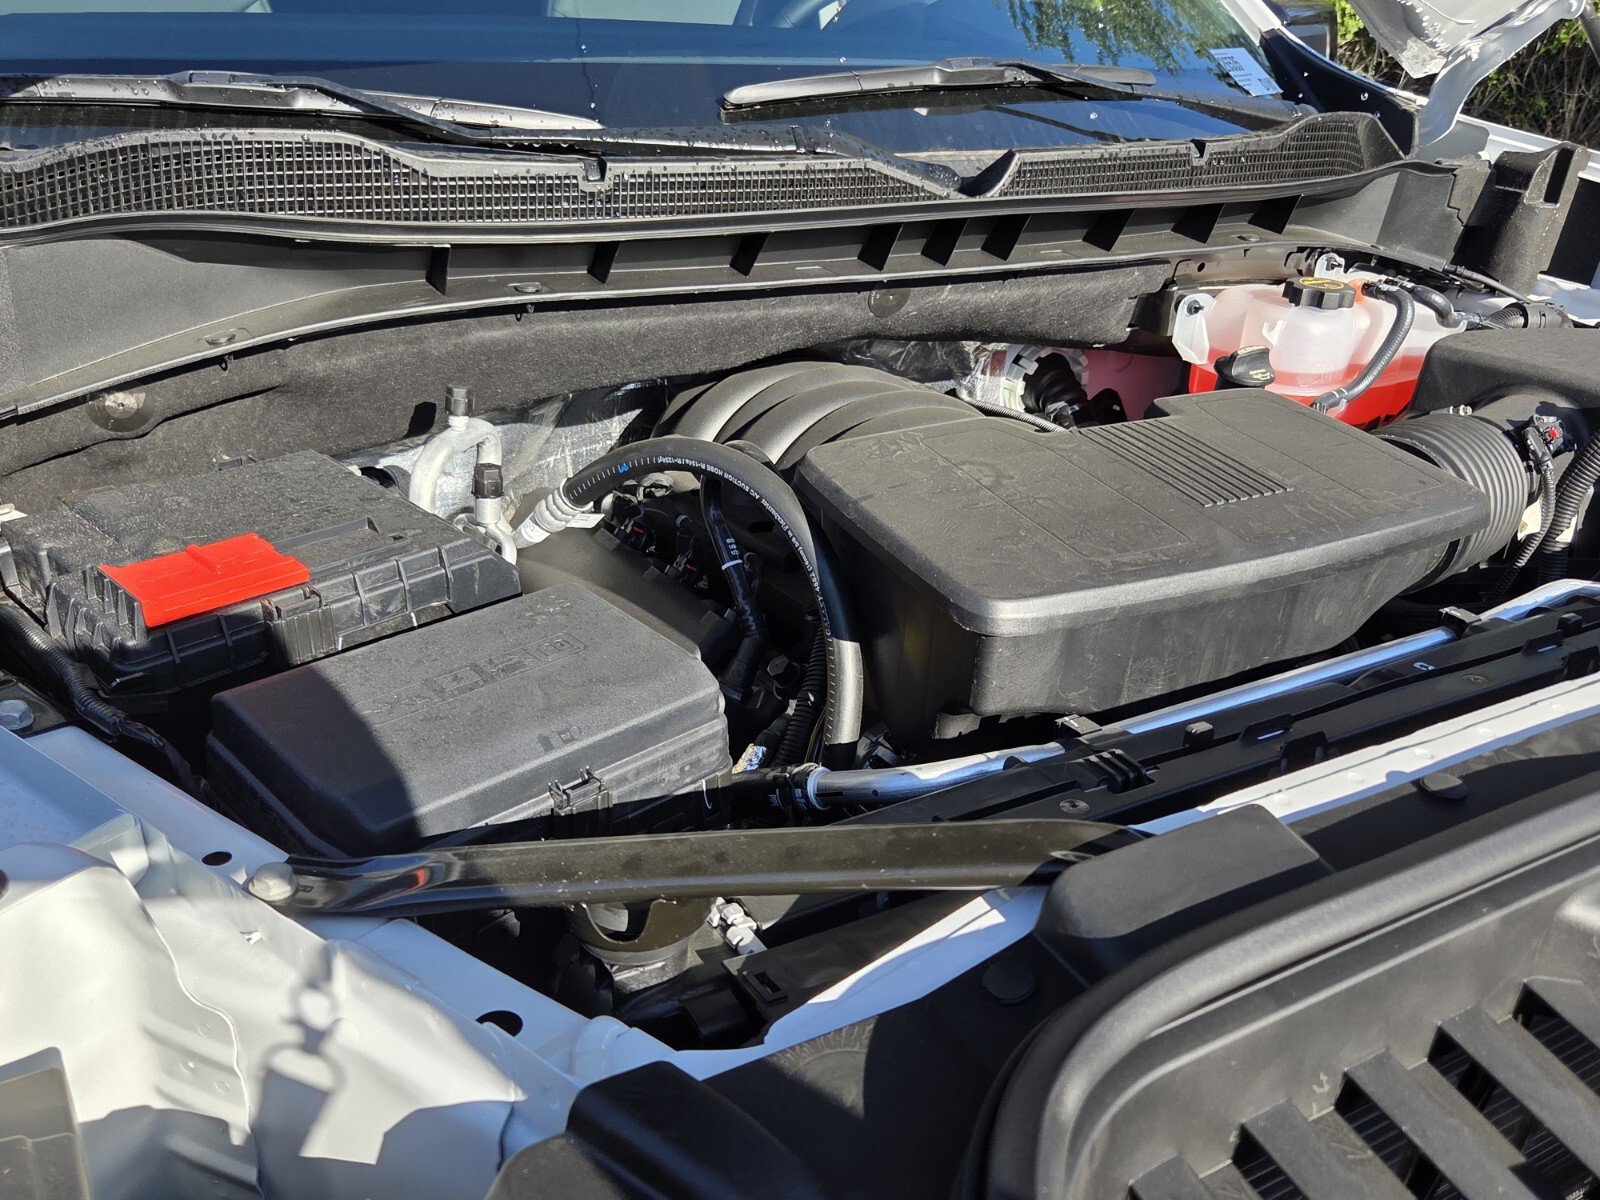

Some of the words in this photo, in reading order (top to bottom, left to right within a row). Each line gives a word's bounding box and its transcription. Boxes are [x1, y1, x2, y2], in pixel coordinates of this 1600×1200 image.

[706, 464, 724, 477] HOSE
[723, 472, 750, 492] SUCTION
[749, 489, 760, 500] A/C
